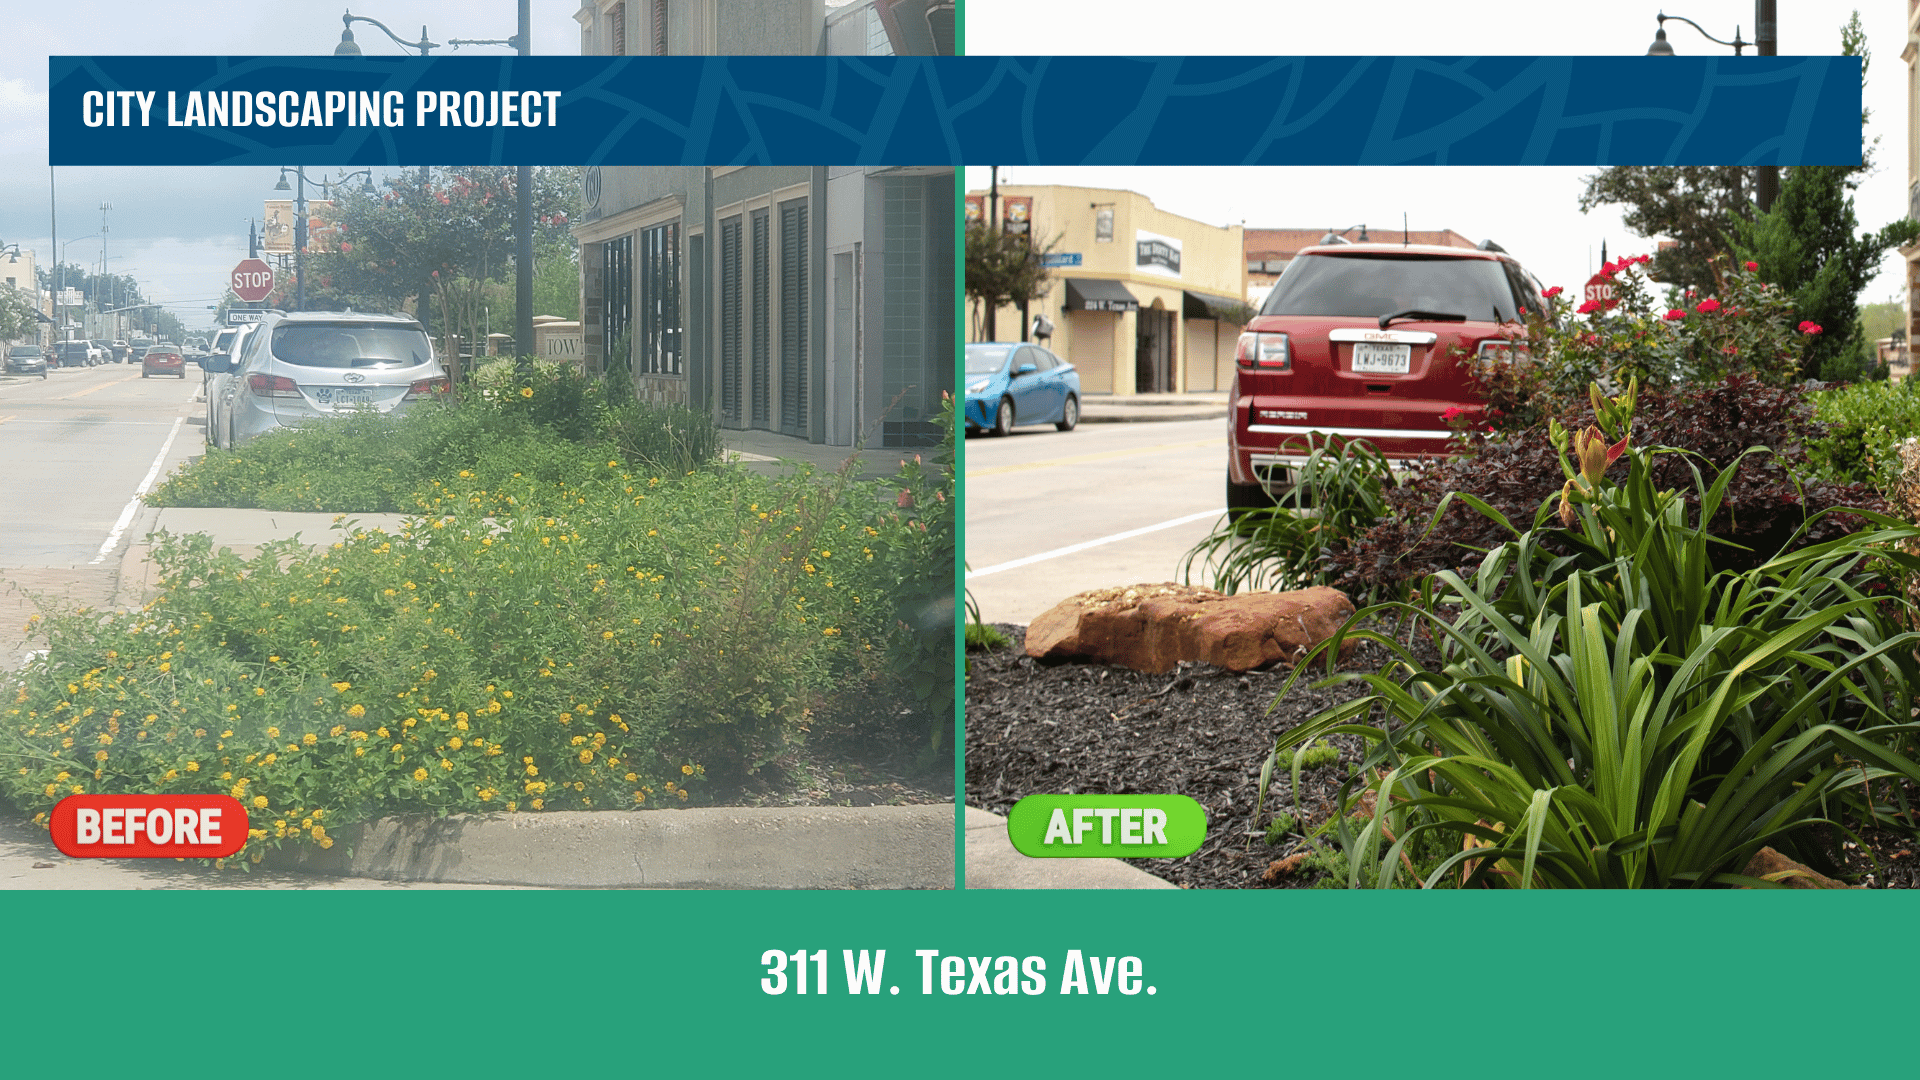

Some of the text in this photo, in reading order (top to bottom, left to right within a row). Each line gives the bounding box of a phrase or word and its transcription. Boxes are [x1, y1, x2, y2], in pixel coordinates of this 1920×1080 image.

[234, 271, 271, 289] STOP
[1586, 284, 1617, 301] STO
[1364, 333, 1399, 341] GMC
[547, 338, 584, 356] TOW
